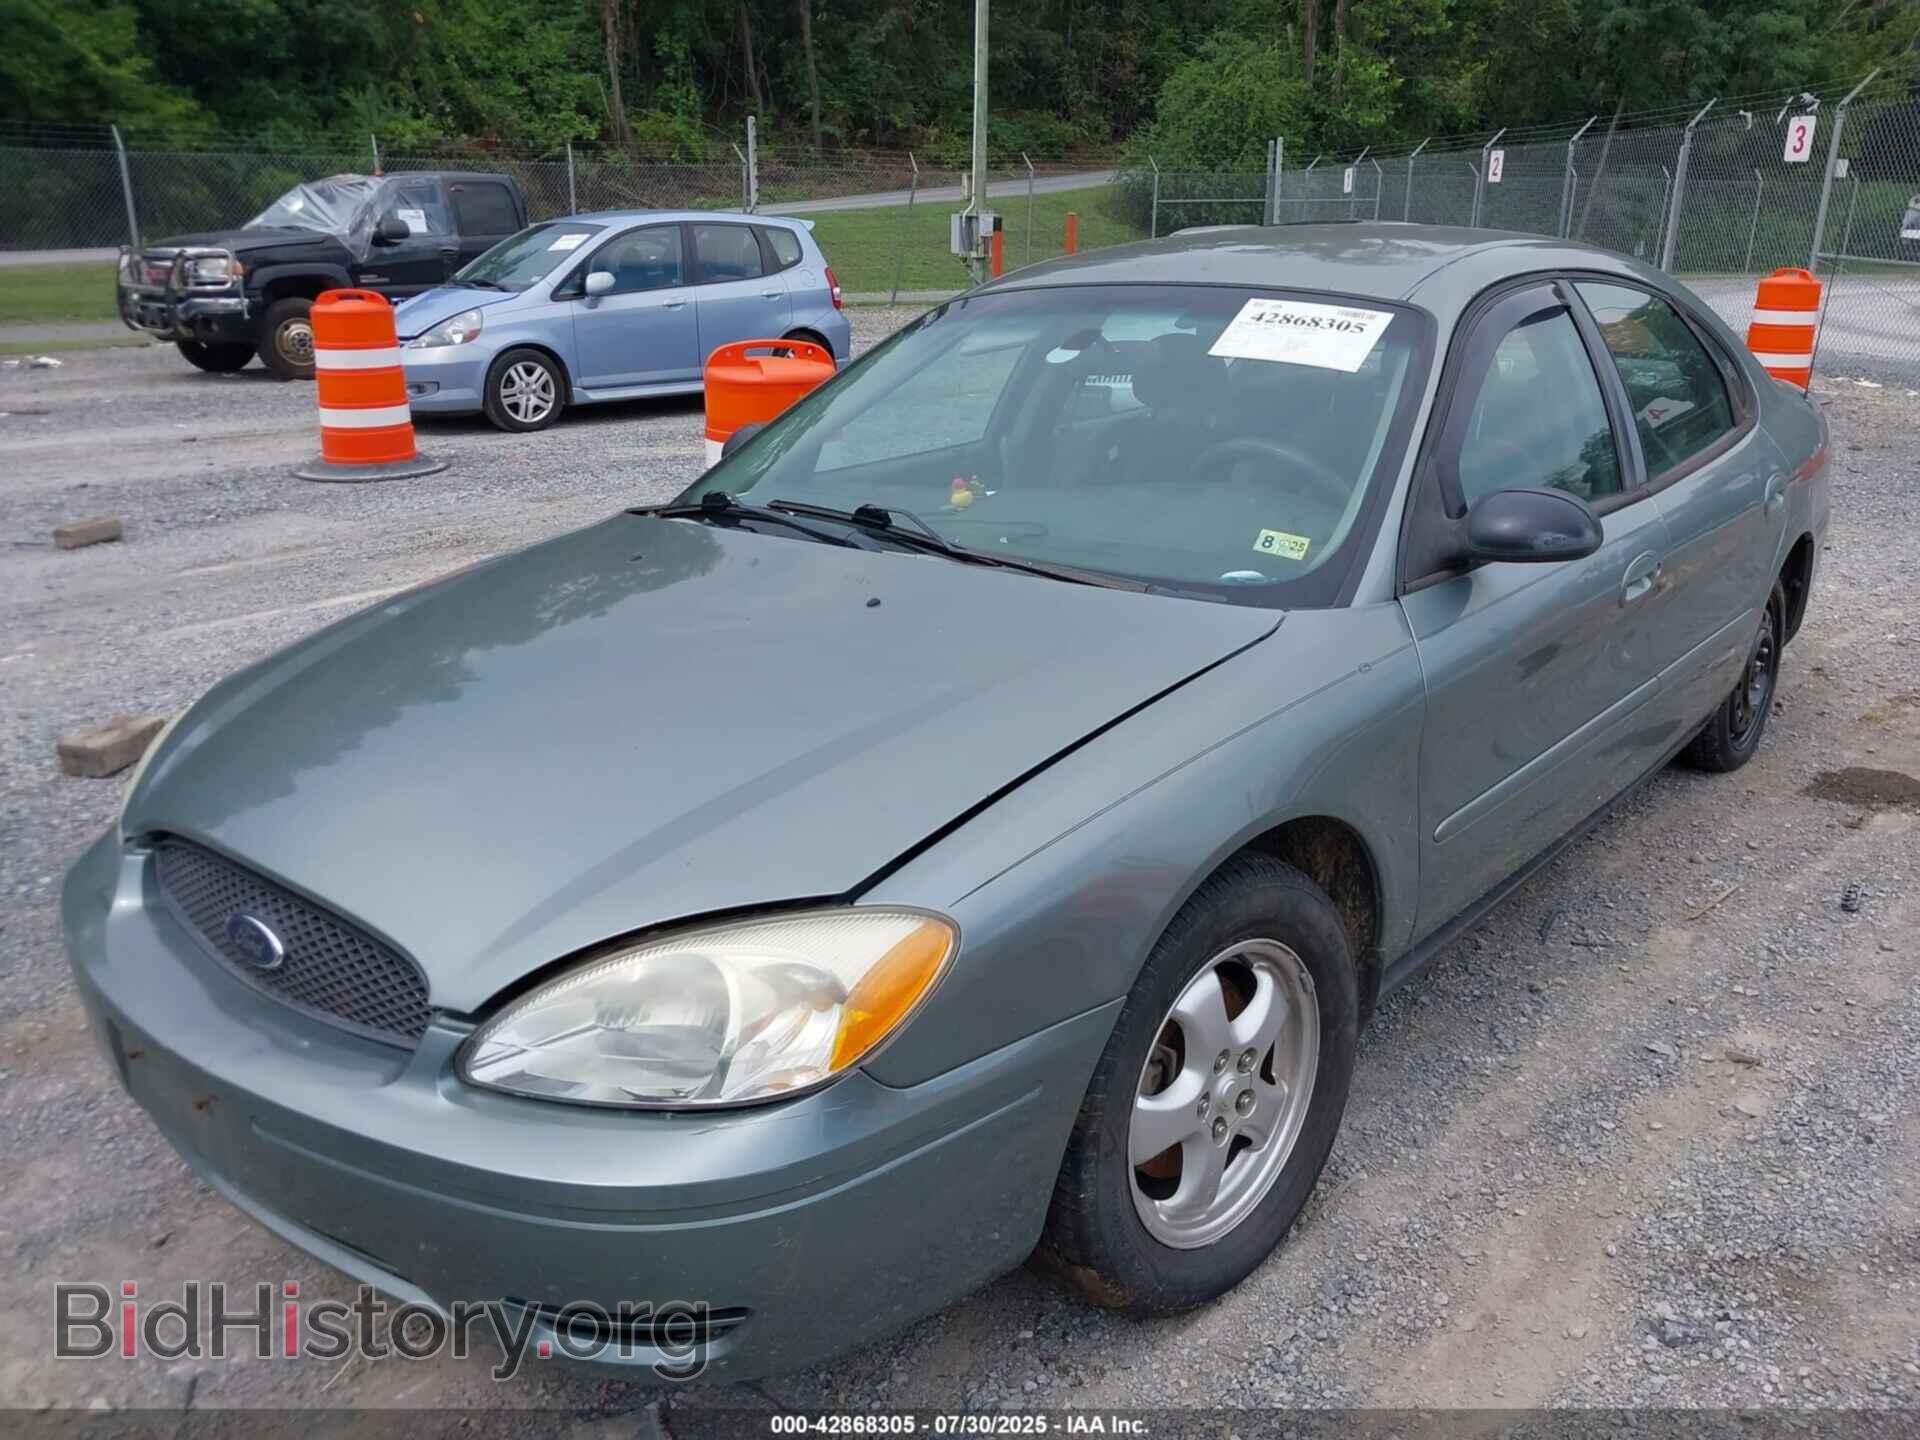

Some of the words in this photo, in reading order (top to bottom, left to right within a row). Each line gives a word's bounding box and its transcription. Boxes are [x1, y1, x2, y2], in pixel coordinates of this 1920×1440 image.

[1792, 124, 1806, 154] 3
[1492, 156, 1500, 177] 2
[1250, 310, 1369, 335] 42868305
[1262, 535, 1275, 549] 8
